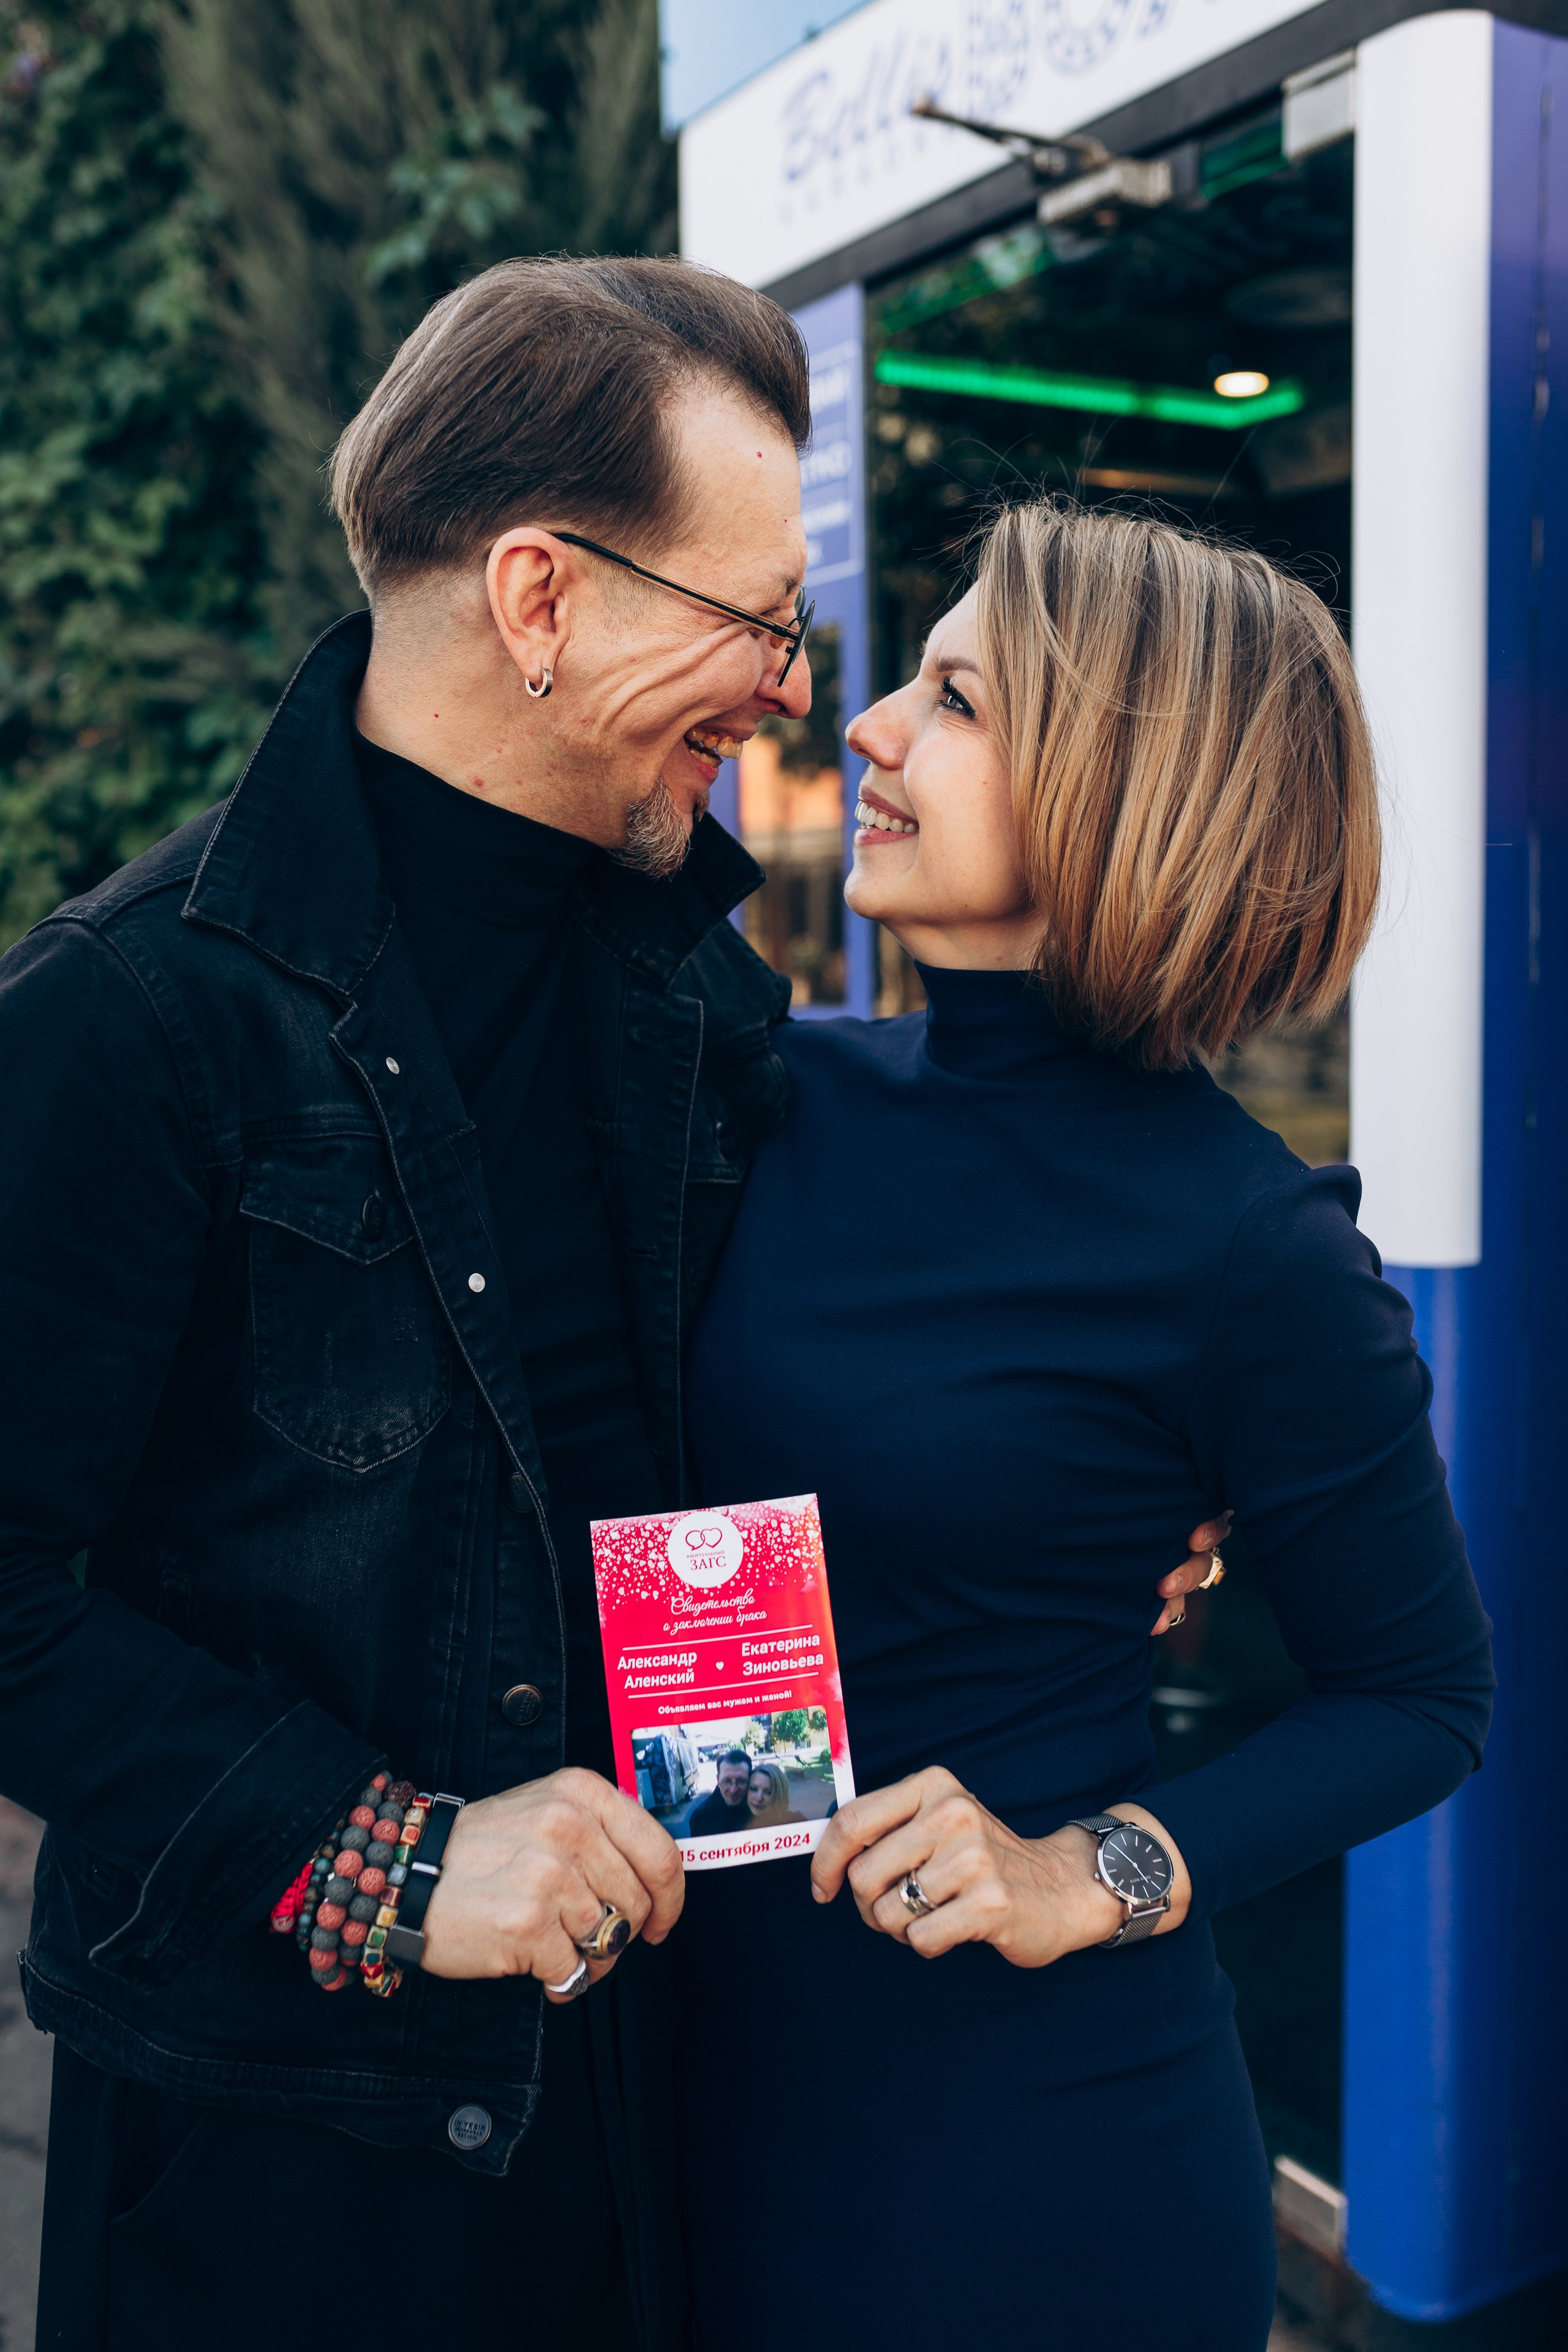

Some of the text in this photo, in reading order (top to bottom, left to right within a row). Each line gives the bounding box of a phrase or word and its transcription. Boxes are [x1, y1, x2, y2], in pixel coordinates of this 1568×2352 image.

[690, 1556, 726, 1570] ЗАГС
[671, 1588, 755, 1617] Свидетельство
[663, 1605, 767, 1636] о заключении брака
[741, 1634, 820, 1657] Екатерина
[617, 1651, 697, 1671] Александр
[742, 1653, 824, 1676] Зиновьева
[624, 1668, 695, 1689] Аленский
[658, 1703, 706, 1715] Объявляем
[707, 1701, 722, 1709] вас
[723, 1696, 753, 1708] мужем
[761, 1689, 793, 1702] женой!
[680, 1833, 811, 1863] 15 сентября 2024
